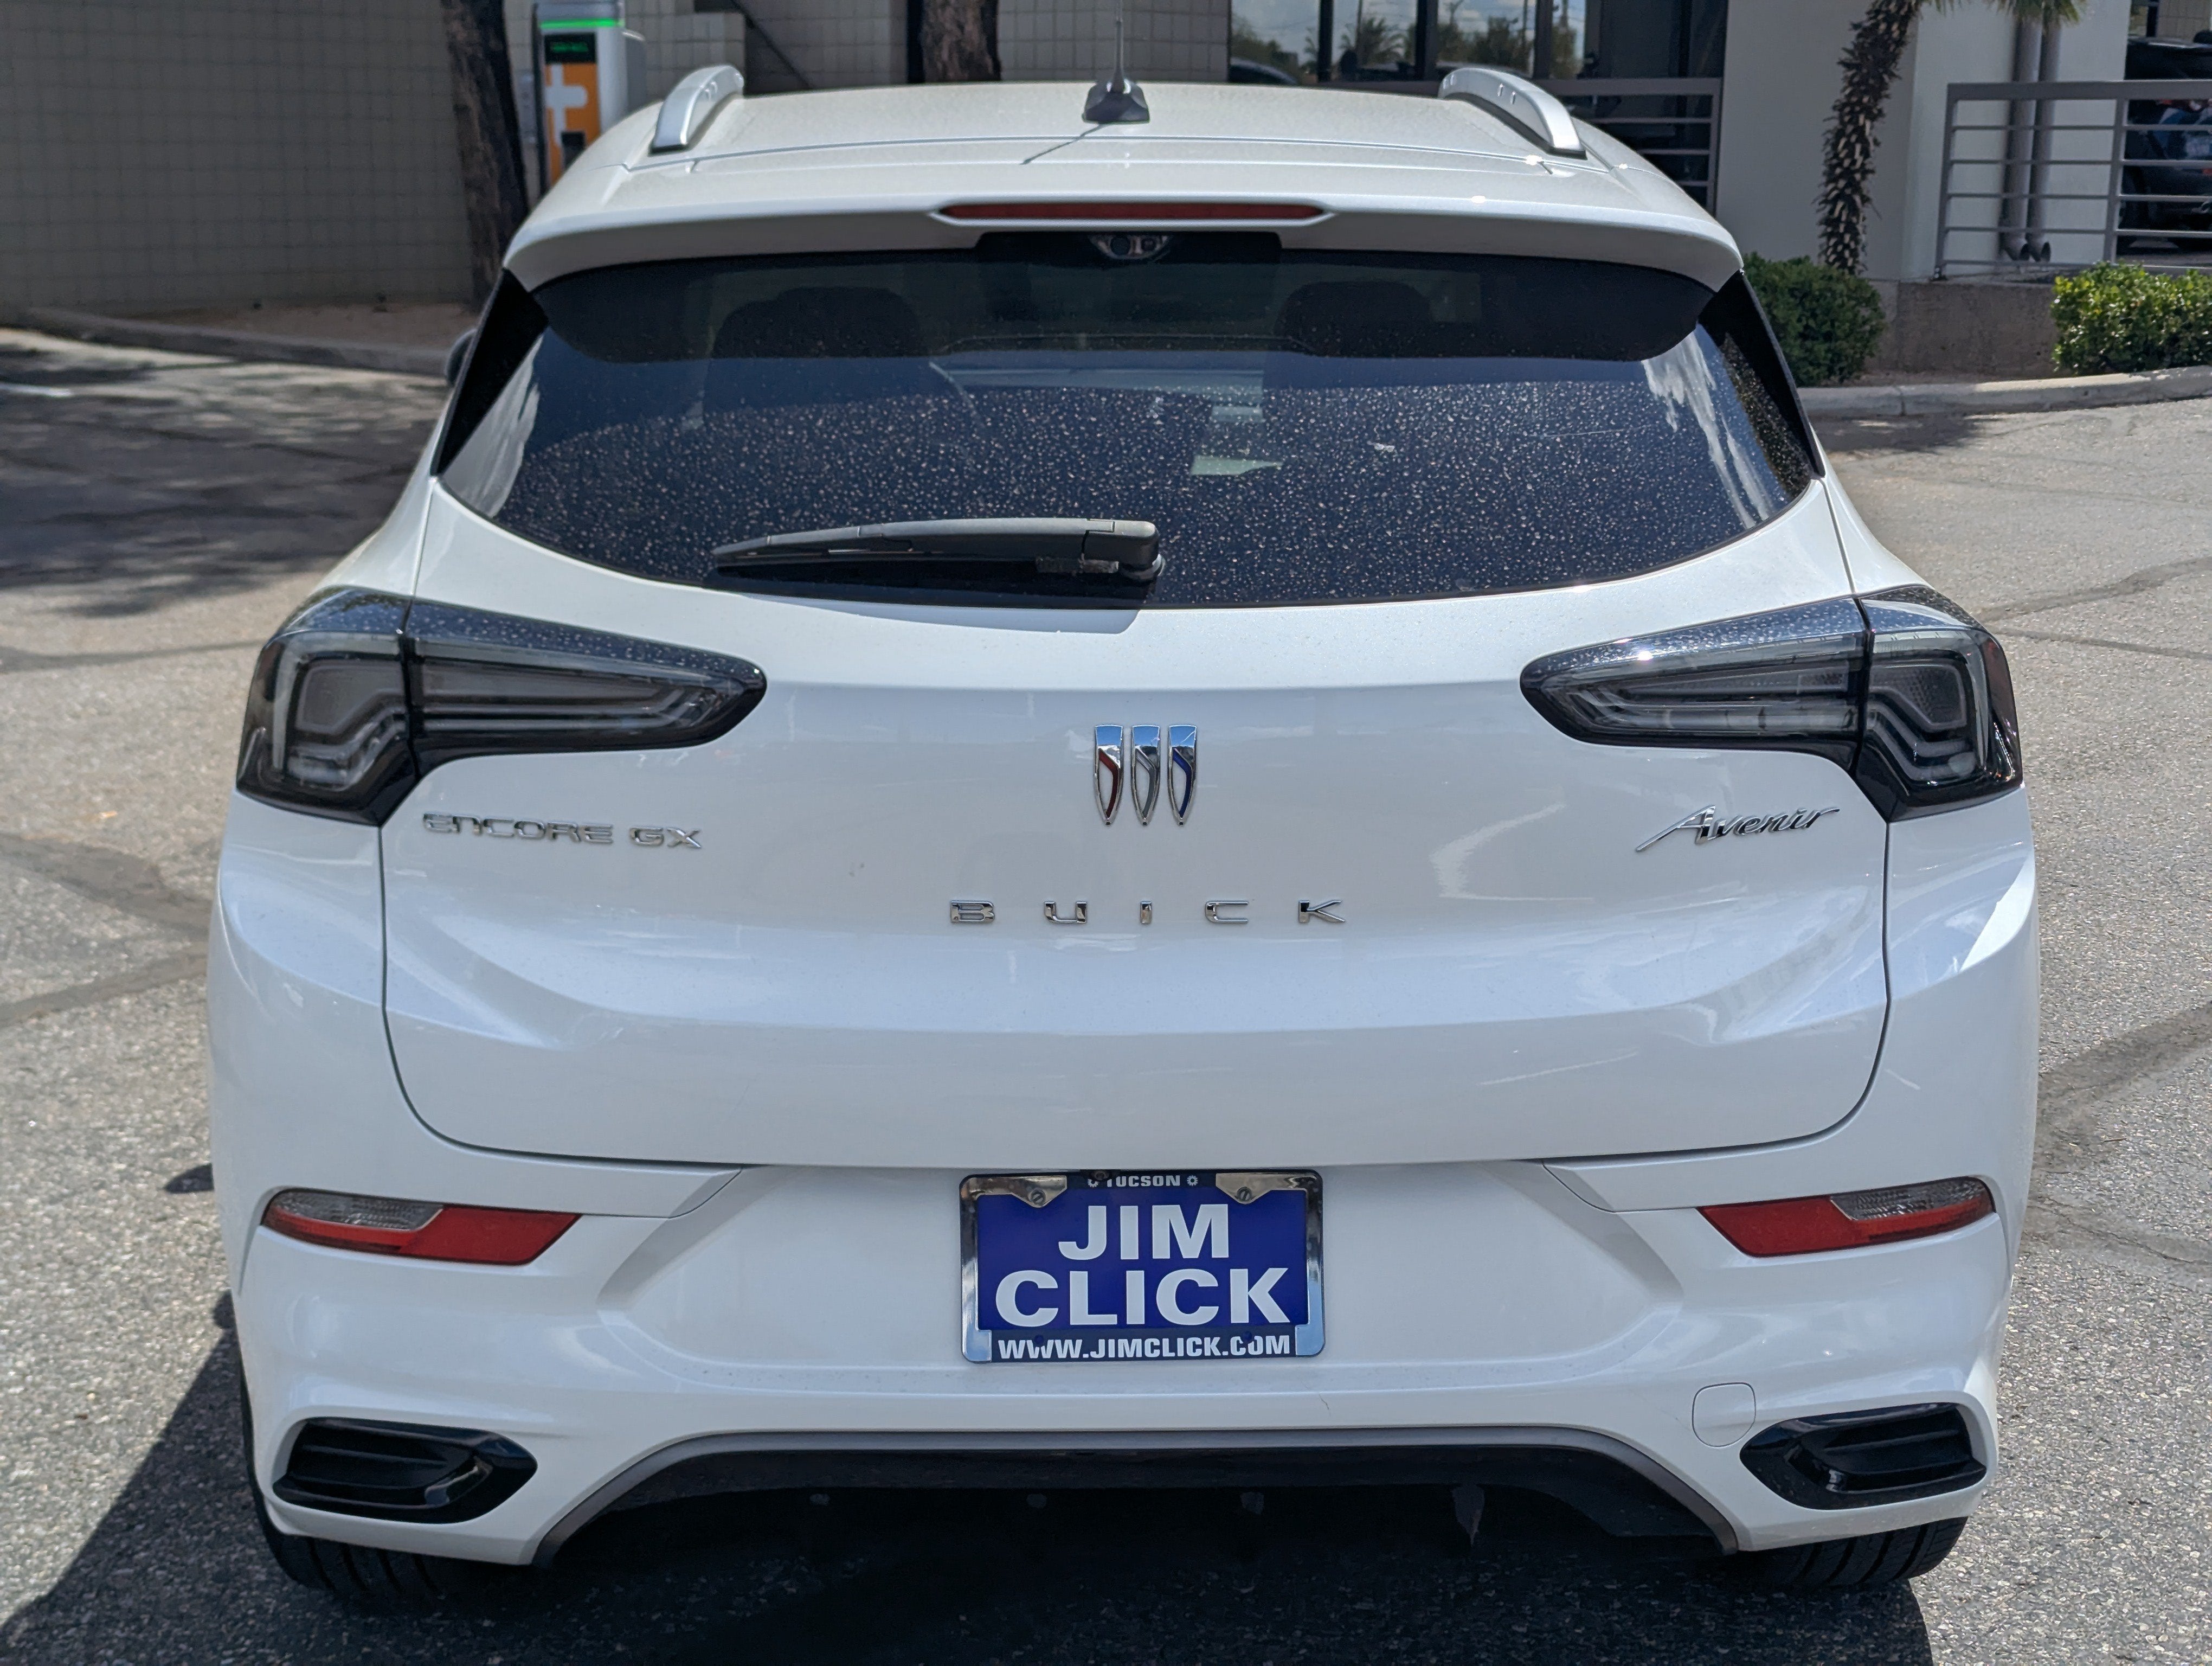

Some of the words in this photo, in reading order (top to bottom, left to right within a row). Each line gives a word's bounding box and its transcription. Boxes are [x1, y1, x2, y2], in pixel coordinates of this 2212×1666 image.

[423, 813, 613, 843] ENCORE
[629, 826, 702, 849] GX
[1635, 804, 1841, 853] Avenir
[950, 900, 1346, 924] BUICK
[1058, 1204, 1230, 1260] JIM
[995, 1267, 1290, 1327] CLICK
[998, 1335, 1290, 1359] WWW.JIMCLICK.COM
